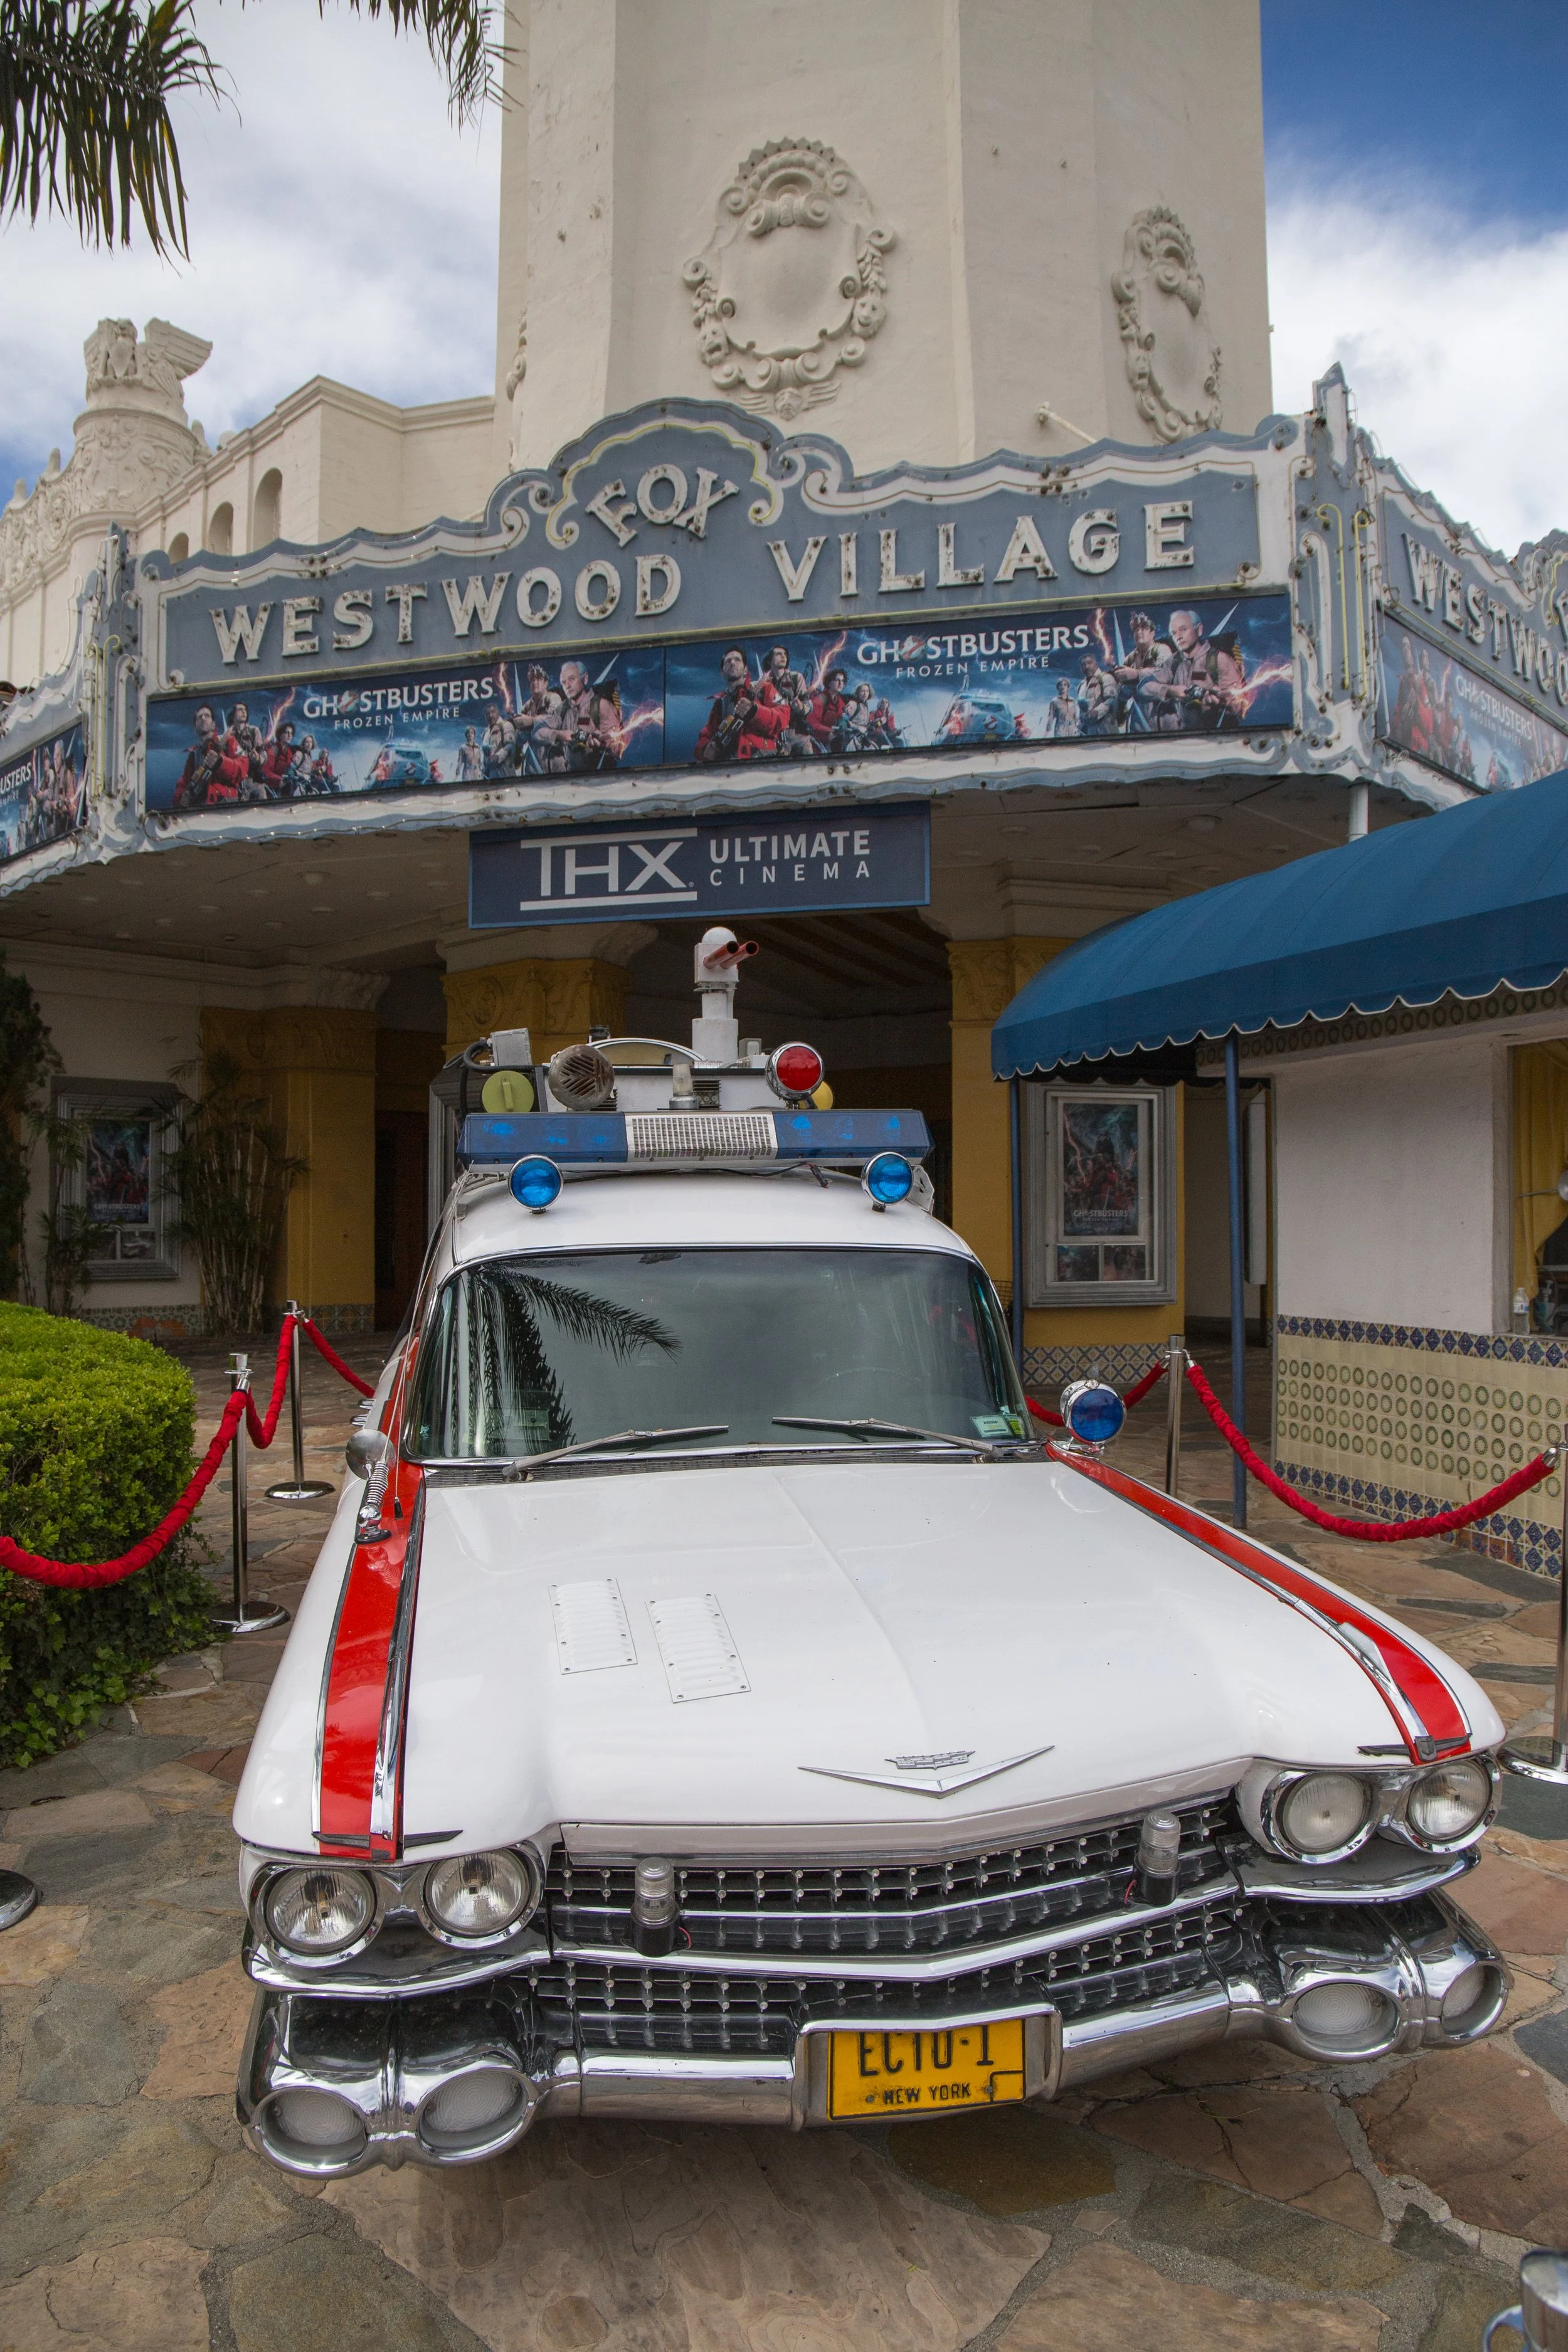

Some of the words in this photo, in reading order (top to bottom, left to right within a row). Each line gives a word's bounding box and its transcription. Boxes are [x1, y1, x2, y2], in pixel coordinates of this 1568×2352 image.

[585, 463, 740, 548] FOX
[209, 553, 682, 664] WESTWOOD
[766, 500, 1195, 601] VILLAGE
[857, 624, 1090, 665] GHOSTBUSTERS
[896, 662, 969, 679] FROZEN
[980, 656, 1050, 672] EMPIRE
[302, 677, 494, 718] GHOSTBUSTERS
[1455, 674, 1533, 741] GHOSTBUSTERS
[334, 714, 394, 730] FROZEN
[403, 707, 460, 723] EMPIRE
[521, 827, 697, 897] THX
[709, 829, 871, 864] ULTIMATE
[709, 860, 871, 887] CINEMA
[882, 2087, 921, 2105] NEW
[929, 2082, 972, 2100] YORK
